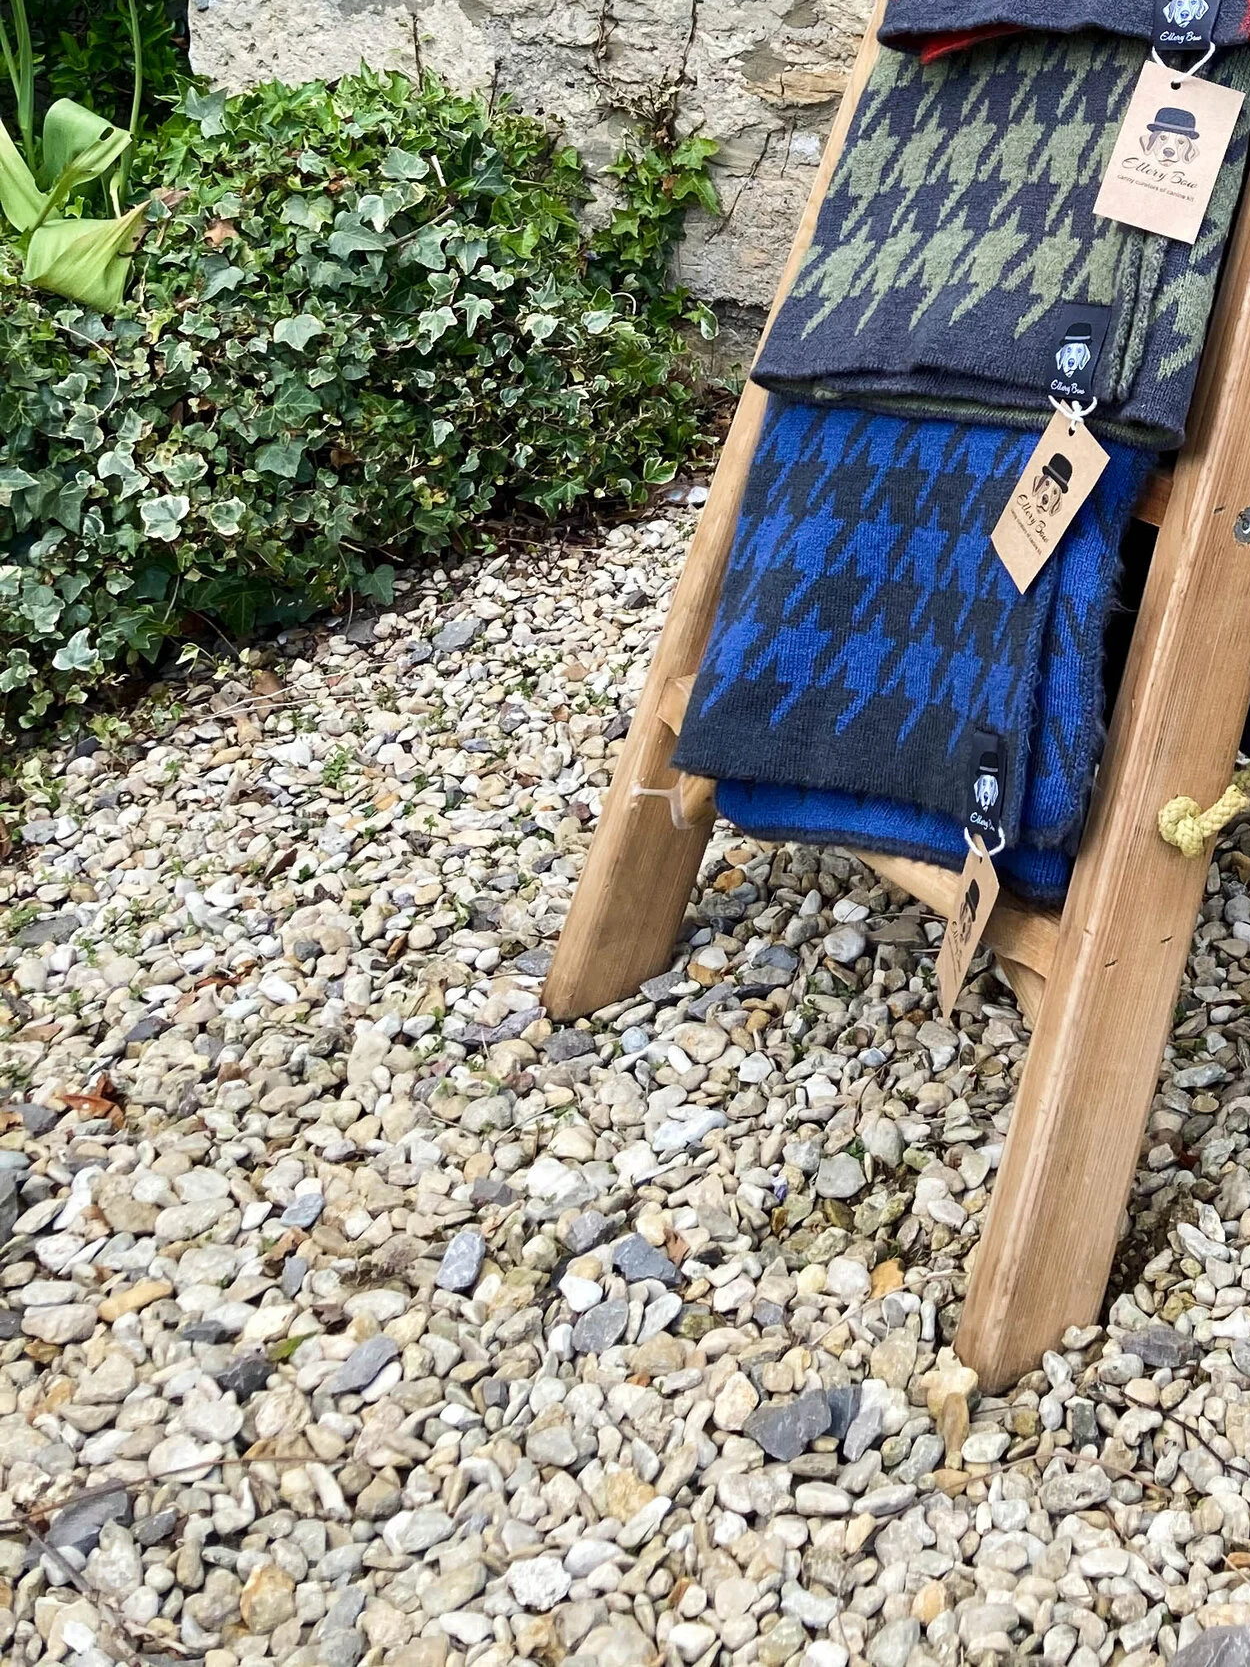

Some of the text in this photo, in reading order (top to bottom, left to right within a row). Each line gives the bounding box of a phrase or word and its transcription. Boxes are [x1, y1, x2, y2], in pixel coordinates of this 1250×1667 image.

[1160, 30, 1186, 44] Ellery
[1121, 157, 1198, 188] Ellery Bow
[1017, 494, 1037, 526] Ellery
